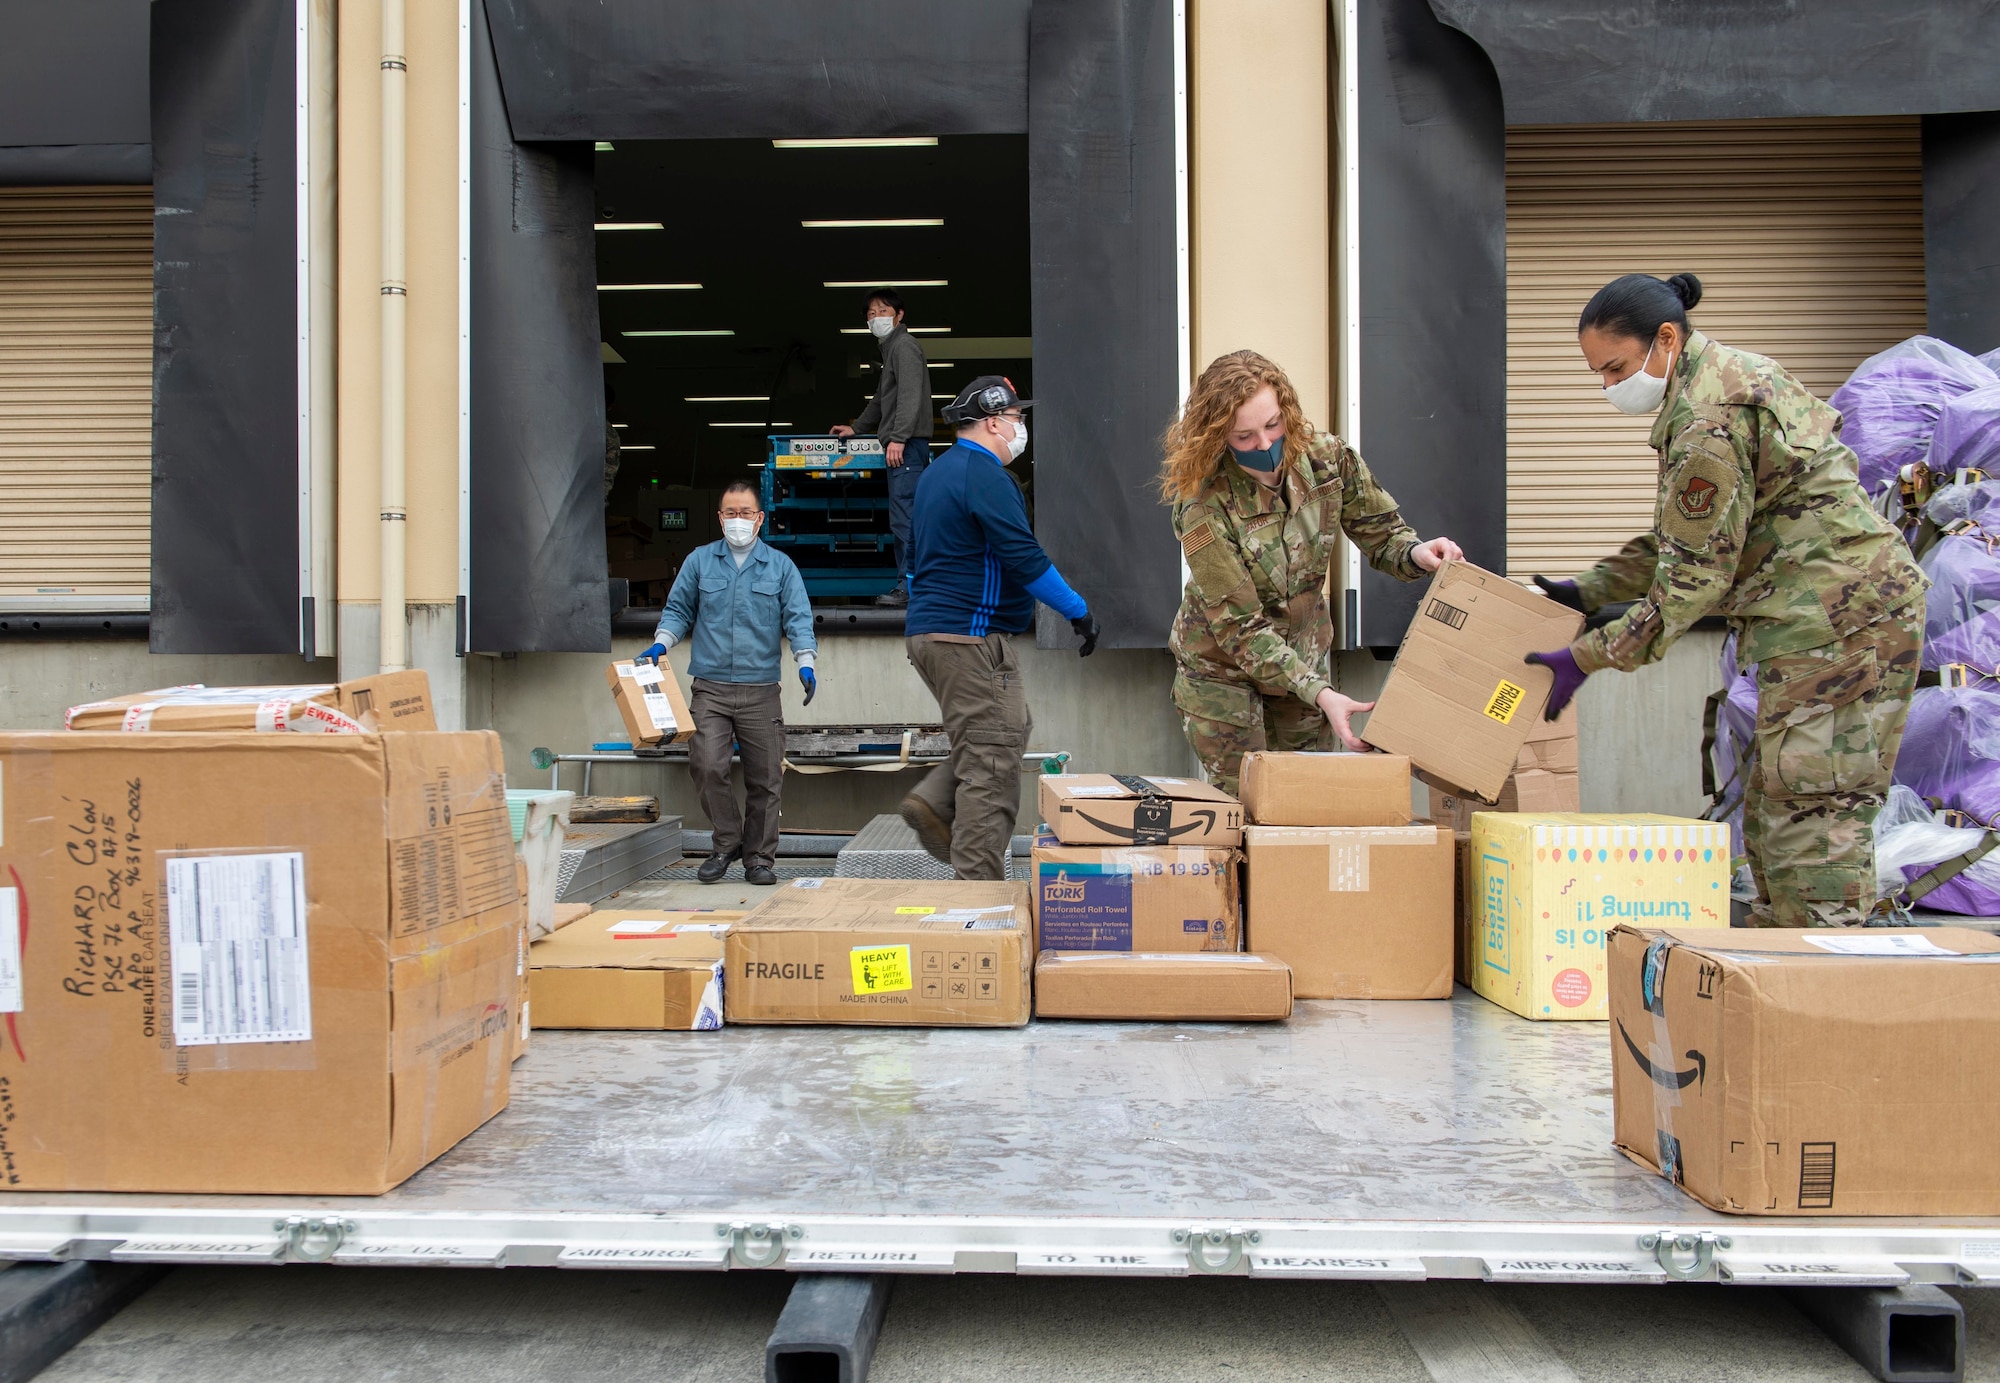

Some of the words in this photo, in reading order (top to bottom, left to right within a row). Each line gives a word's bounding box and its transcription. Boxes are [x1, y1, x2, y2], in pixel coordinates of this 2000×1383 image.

[1318, 481, 1341, 496] FORCE
[1488, 684, 1520, 720] FRAGILE
[124, 776, 143, 888] 96319-0026
[1141, 863, 1163, 876] HB
[1169, 863, 1186, 876] 19
[1191, 863, 1210, 876] 95
[98, 868, 122, 911] Box
[1046, 887, 1083, 899] TORK
[142, 890, 155, 926] SEAT
[1487, 875, 1496, 949] bello
[1496, 876, 1505, 951] hello
[1577, 901, 1595, 922] 1!
[1601, 895, 1692, 922] turning
[102, 923, 124, 946] 76
[127, 910, 143, 938] AP
[142, 928, 155, 961] CAR
[1556, 929, 1575, 949] is
[127, 952, 145, 990] APO
[745, 962, 824, 980] FRAGILE
[861, 952, 897, 963] HEAVY
[101, 955, 125, 994] PSC
[158, 949, 171, 1004] D'AUTO
[882, 971, 902, 979] WITH
[883, 978, 904, 986] CARE
[143, 964, 155, 1037] ONE4LIFE
[839, 994, 865, 1004] MADE
[867, 995, 877, 1004] IN
[880, 994, 909, 1005] CHINA
[116, 1241, 264, 1253] PROPERTY
[361, 1244, 393, 1255] OF
[568, 1247, 704, 1259] AIRFORCE
[809, 1250, 918, 1261] RETURN
[1041, 1254, 1077, 1263] TO
[1093, 1254, 1148, 1265] THE
[1260, 1256, 1392, 1268] NEAREST
[1500, 1259, 1641, 1272] AIRFORCE
[1764, 1262, 1843, 1275] BASE
